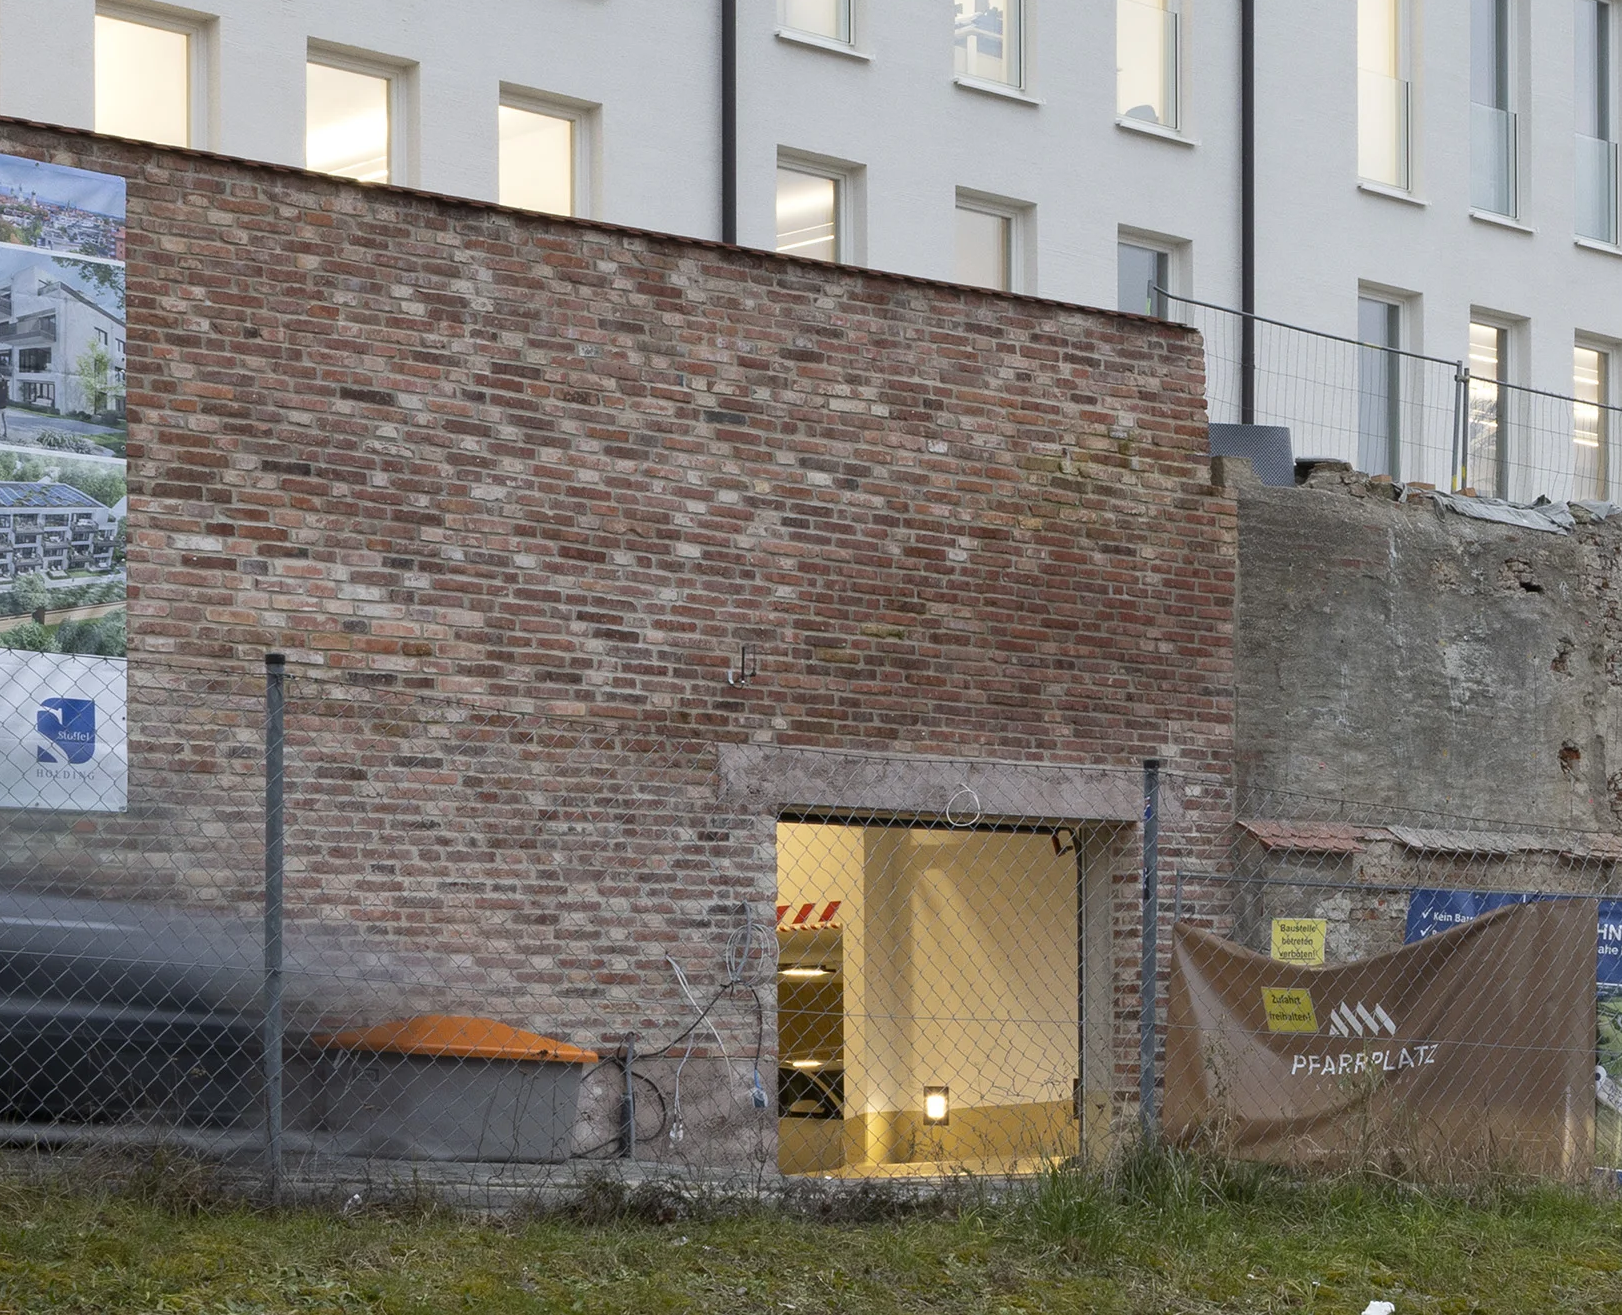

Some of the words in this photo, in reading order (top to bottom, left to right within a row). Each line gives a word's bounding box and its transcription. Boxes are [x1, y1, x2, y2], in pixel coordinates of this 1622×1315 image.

[56, 730, 90, 742] Stoffel
[36, 769, 95, 781] HOLDING
[1433, 911, 1452, 923] Kein
[1280, 924, 1316, 933] Baustelle
[1282, 936, 1313, 946] betreten
